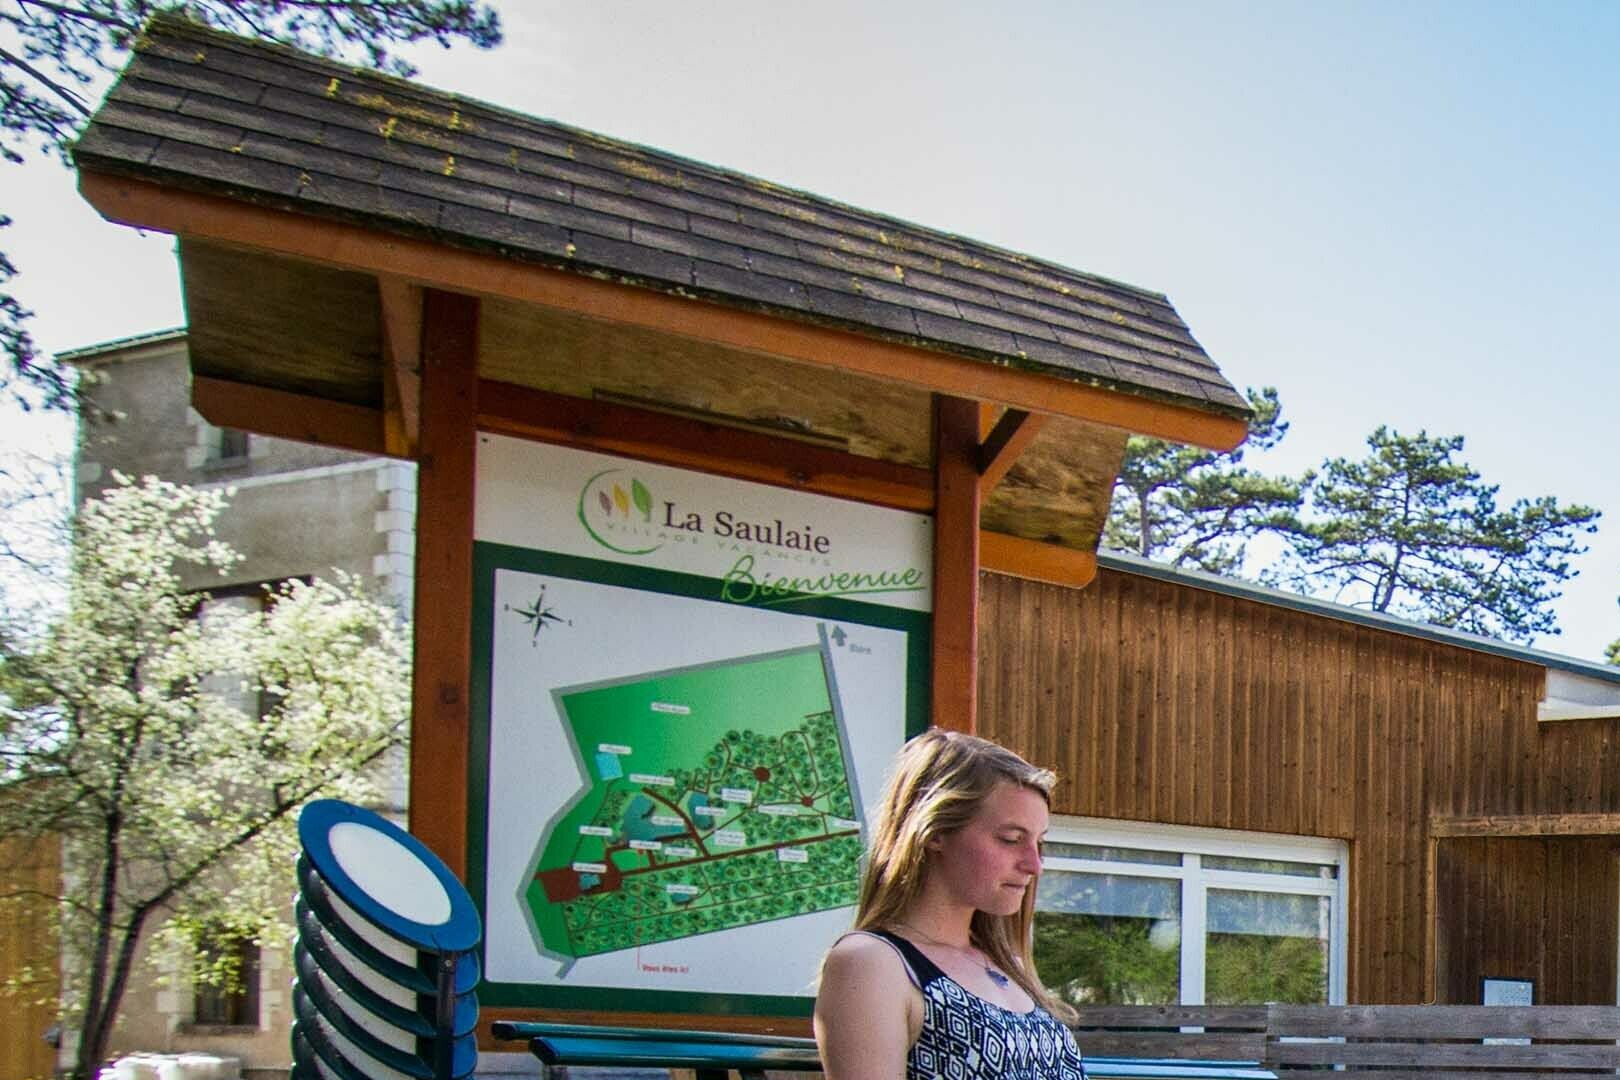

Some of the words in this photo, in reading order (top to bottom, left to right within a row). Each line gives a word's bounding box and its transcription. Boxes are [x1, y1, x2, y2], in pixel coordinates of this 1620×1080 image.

[664, 501, 704, 533] La
[714, 510, 831, 554] Saulaie
[720, 554, 924, 603] Bienvenue
